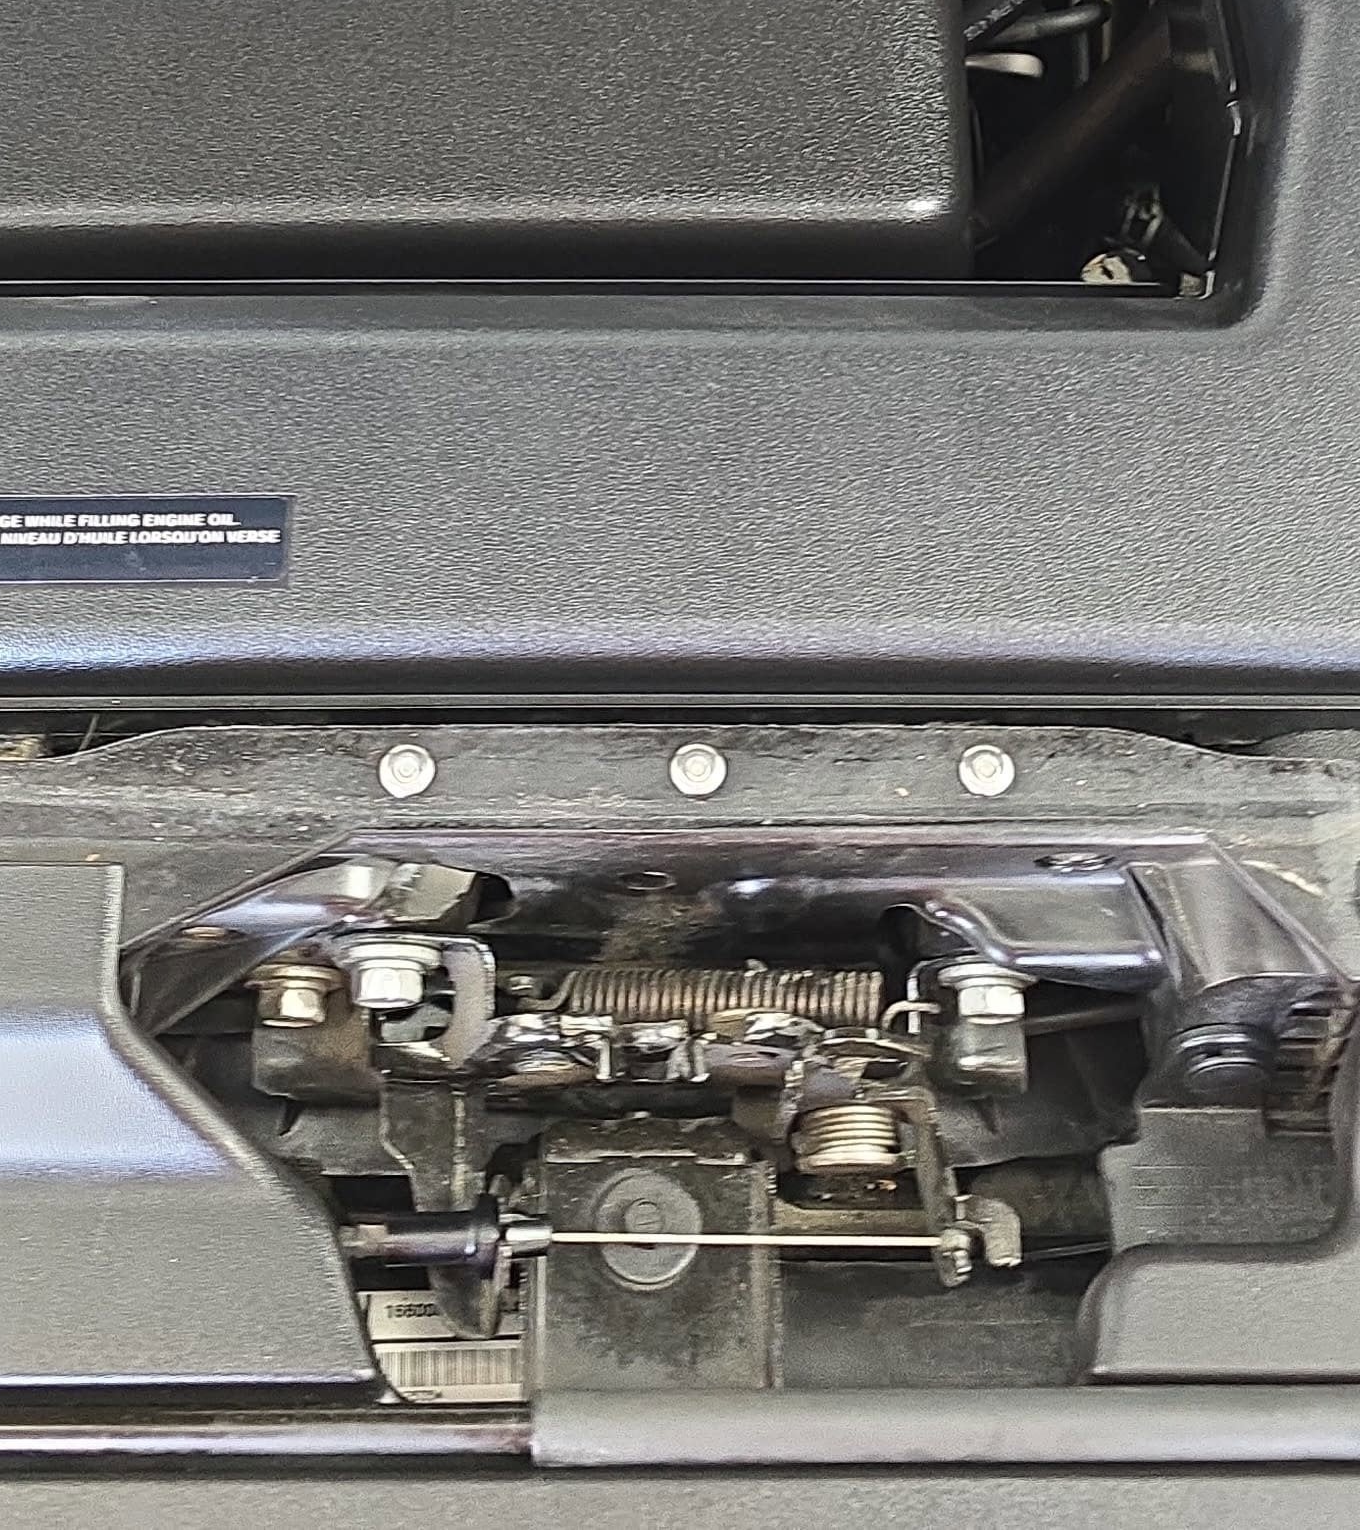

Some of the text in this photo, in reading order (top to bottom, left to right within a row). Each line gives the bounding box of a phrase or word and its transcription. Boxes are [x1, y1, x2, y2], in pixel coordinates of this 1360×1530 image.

[24, 515, 76, 527] WHILE
[77, 514, 140, 526] FILLING
[142, 513, 206, 526] ENGINE
[0, 532, 61, 545] NIVEAU
[62, 531, 129, 544] D'HUILE
[226, 530, 281, 544] VERSE
